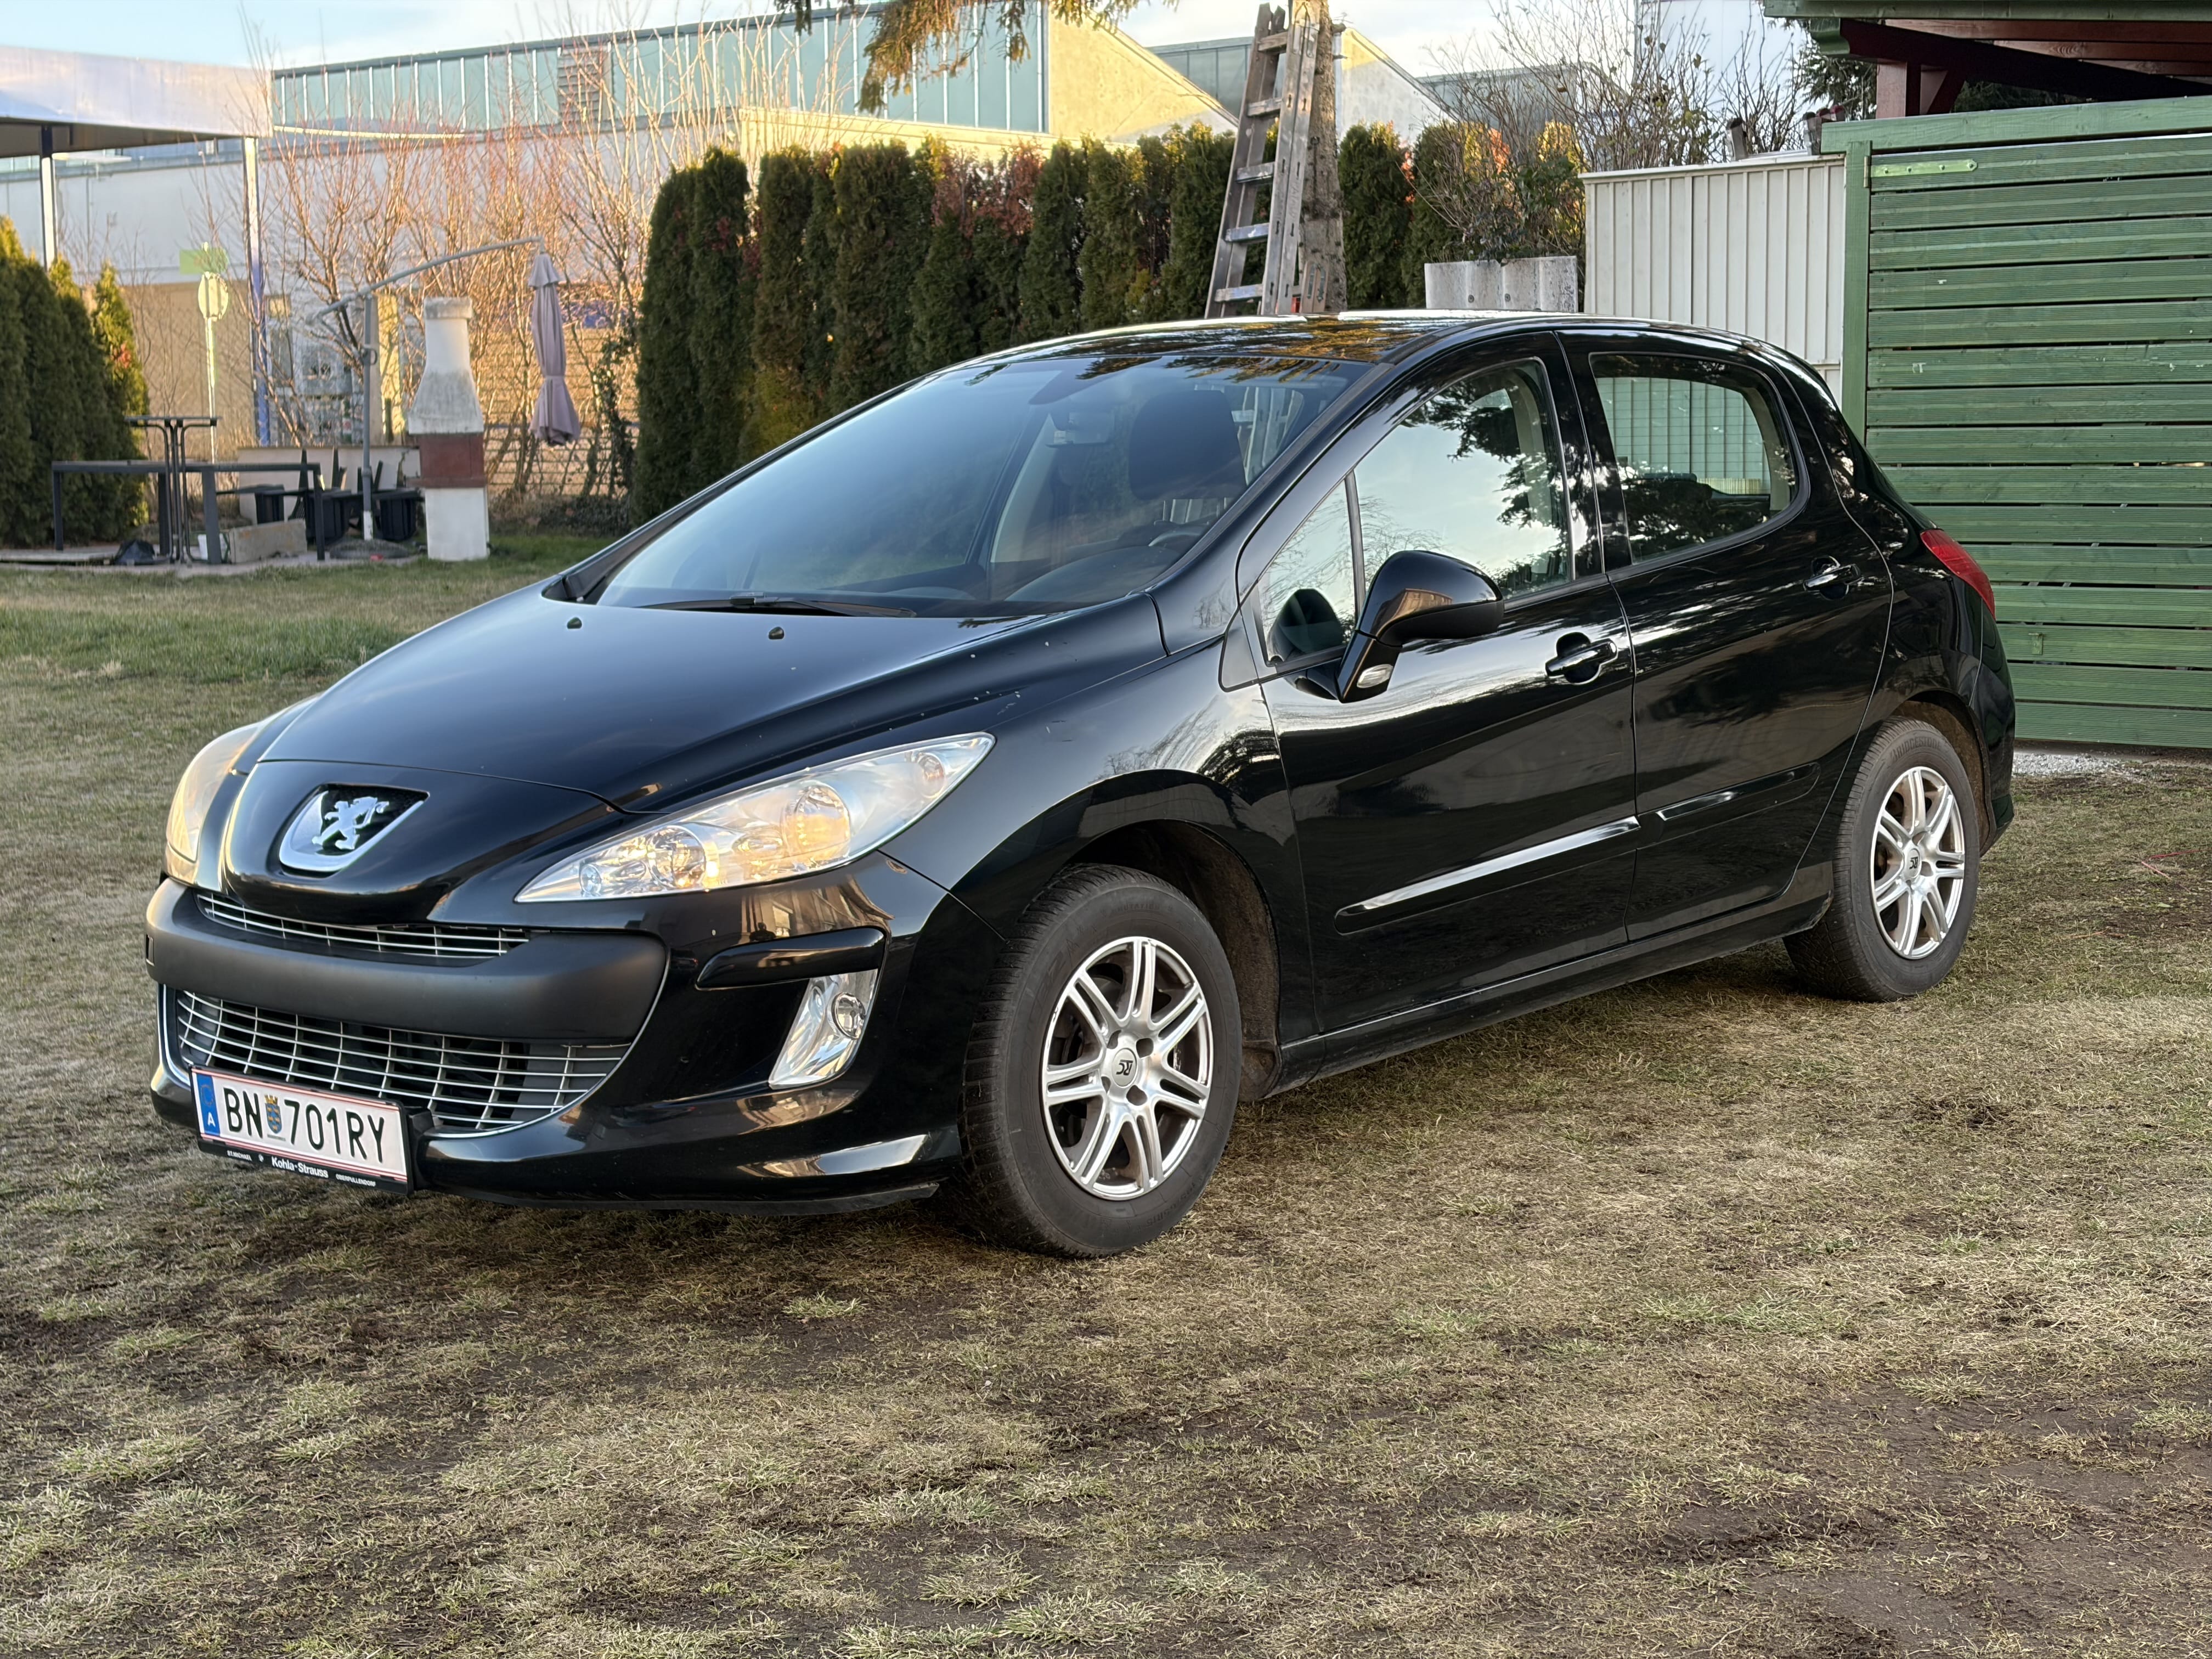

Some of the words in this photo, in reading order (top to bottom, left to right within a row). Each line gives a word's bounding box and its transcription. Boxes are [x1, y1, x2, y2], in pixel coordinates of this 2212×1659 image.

[207, 1112, 216, 1127] A
[223, 1087, 263, 1139] BN
[284, 1099, 385, 1163] 701RY
